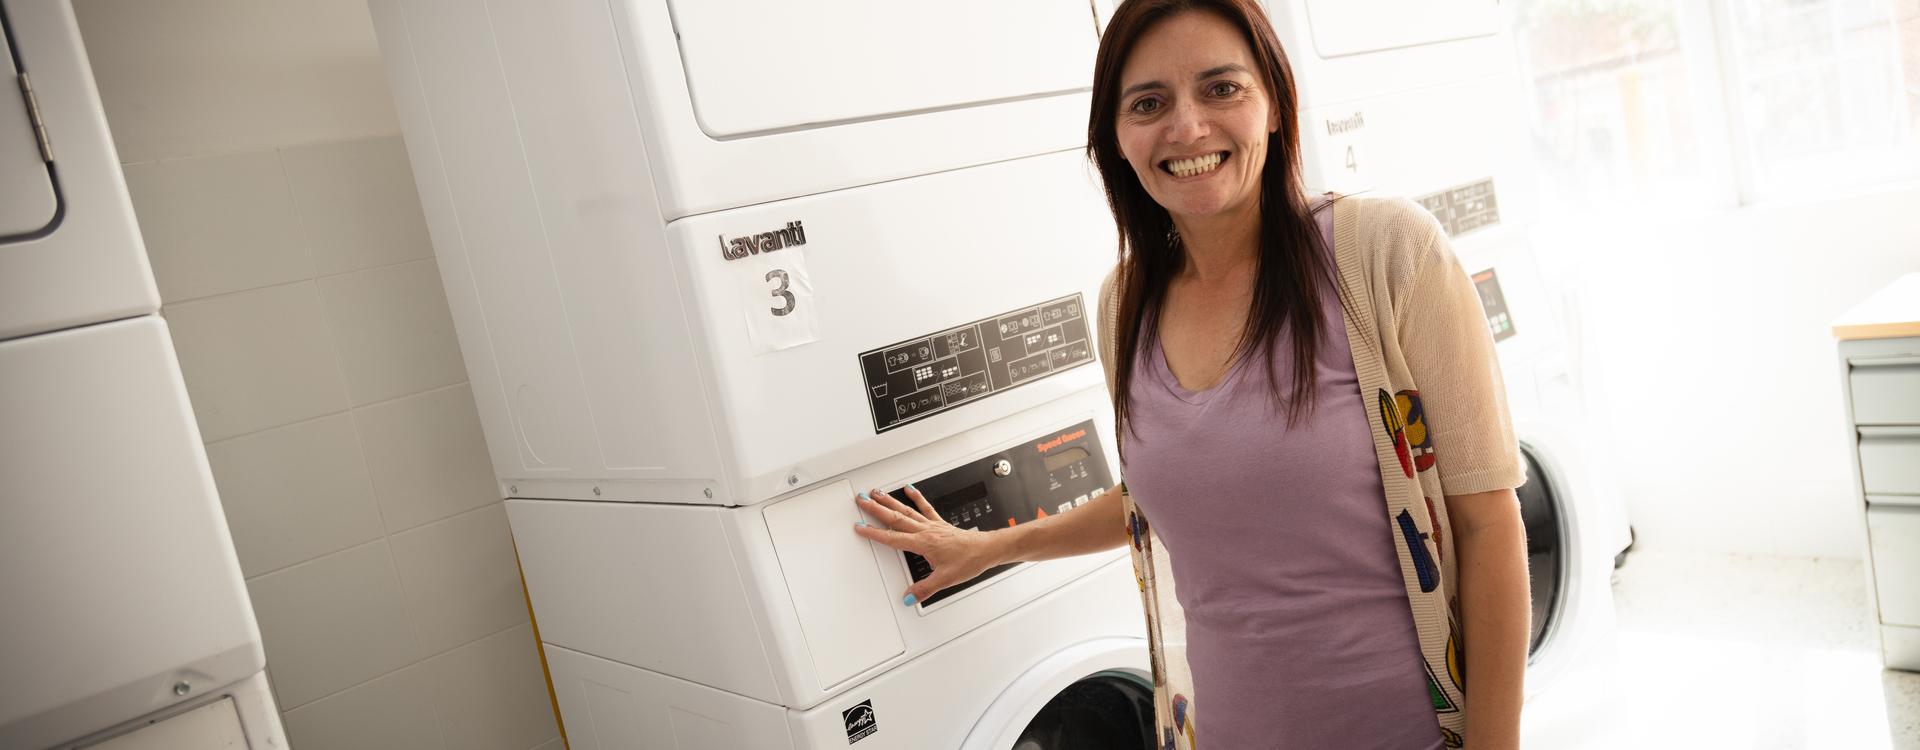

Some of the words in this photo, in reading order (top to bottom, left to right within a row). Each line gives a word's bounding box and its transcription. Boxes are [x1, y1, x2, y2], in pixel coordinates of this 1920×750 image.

[1345, 145, 1358, 173] 4
[719, 220, 807, 261] Lavanti
[765, 269, 796, 317] 3
